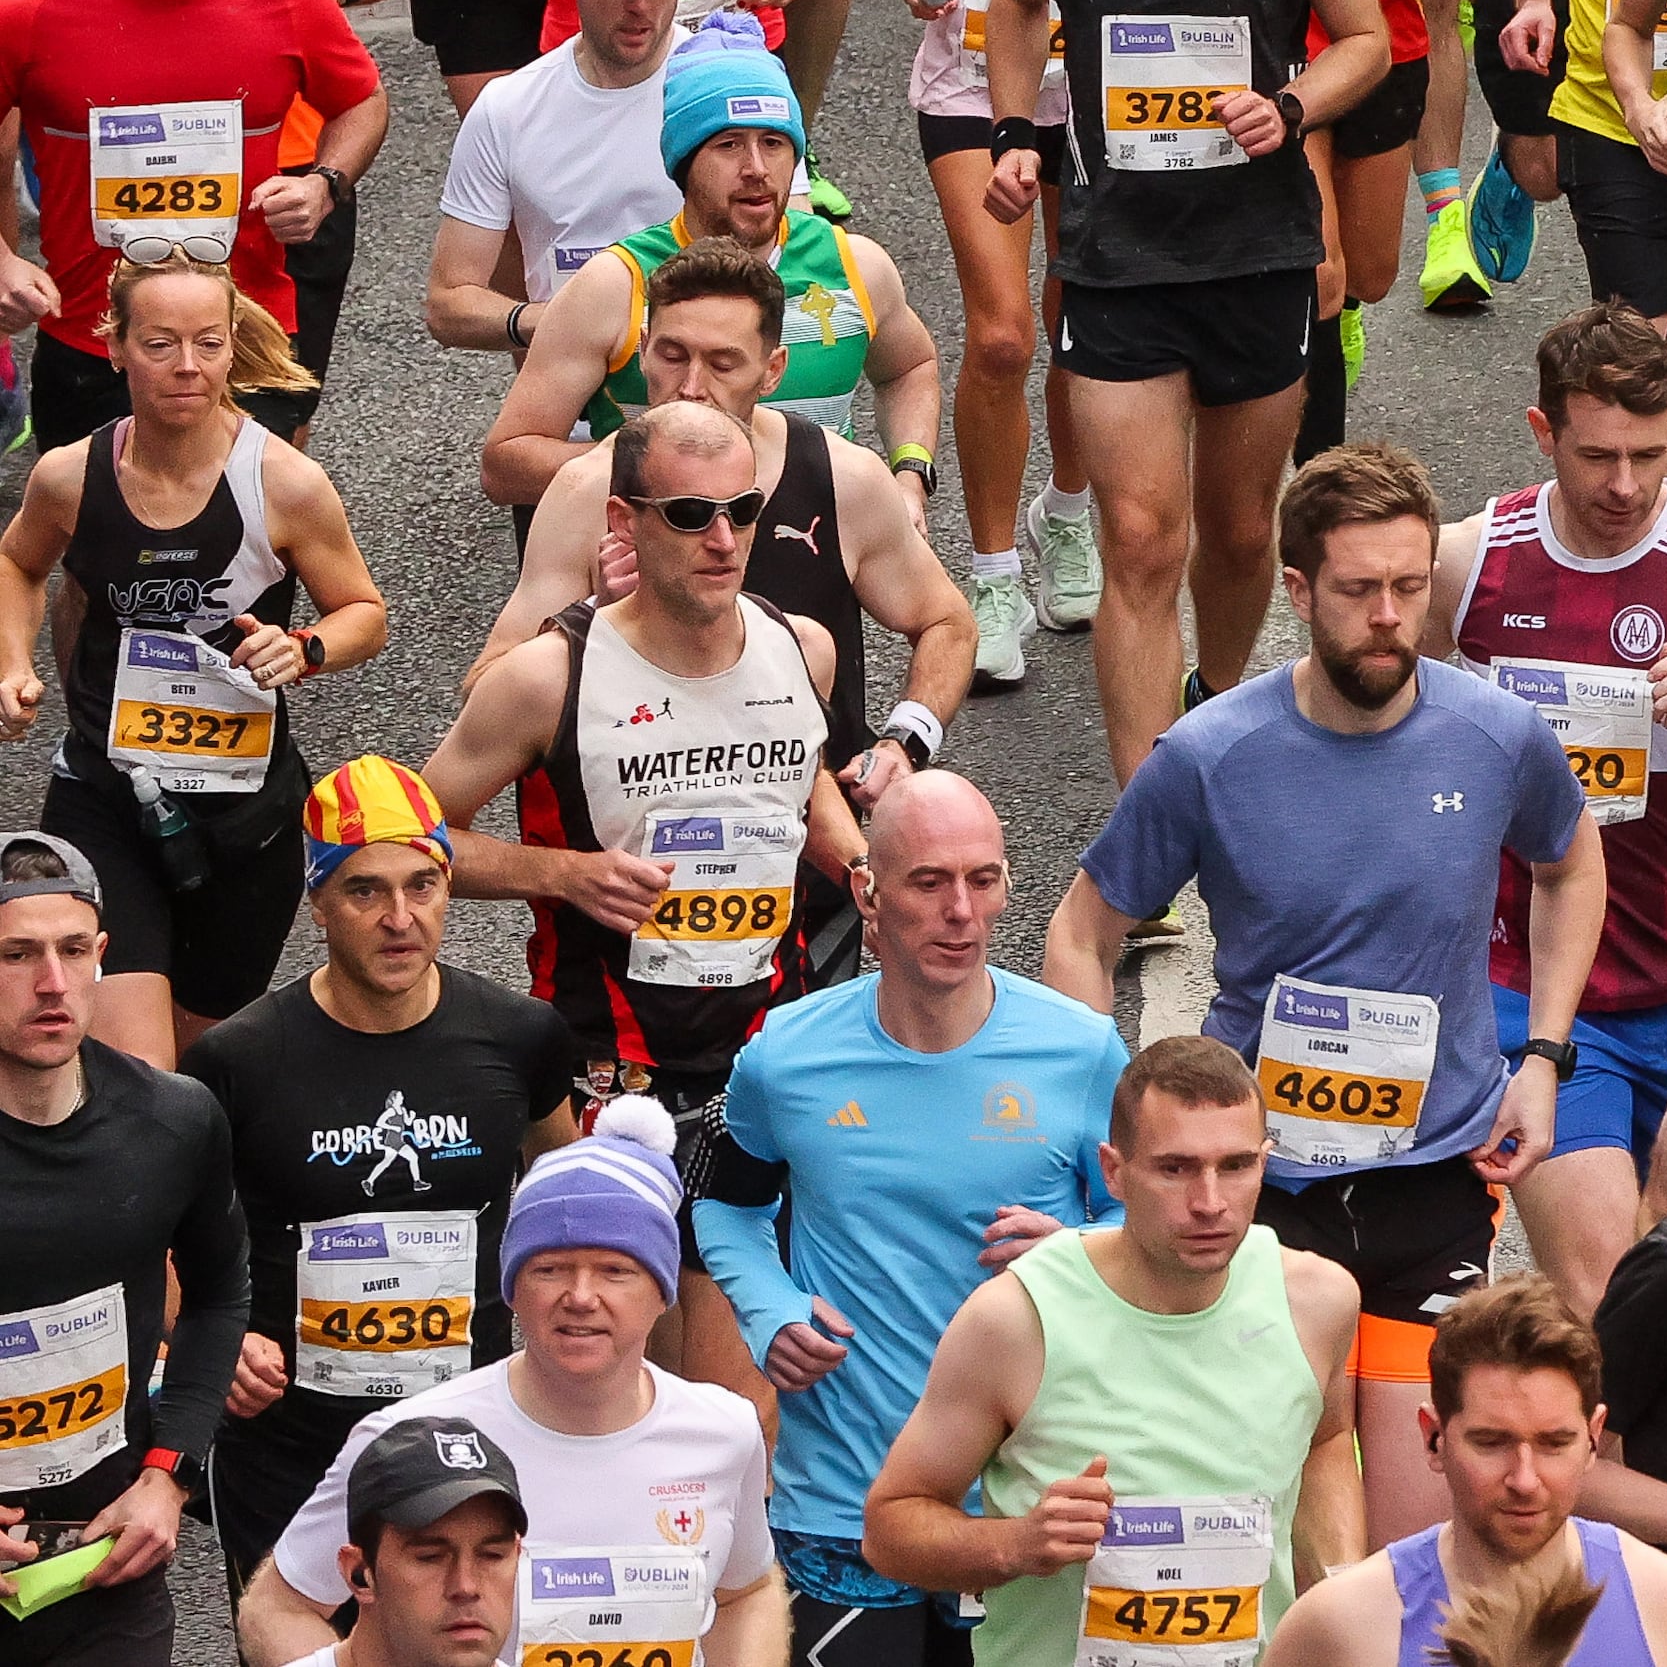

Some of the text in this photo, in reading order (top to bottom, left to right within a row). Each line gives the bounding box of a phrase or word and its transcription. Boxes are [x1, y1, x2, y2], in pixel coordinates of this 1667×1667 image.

[1127, 32, 1167, 46] Irish Life
[1181, 31, 1234, 47] DUBLIN
[1125, 92, 1233, 123] 3782
[1149, 133, 1179, 143] JAMES
[1164, 157, 1194, 168] 3782
[114, 179, 224, 213] 4283
[1502, 613, 1546, 628] KCS
[171, 683, 197, 695] BETH
[1514, 679, 1560, 697] Irish Life
[1575, 682, 1635, 701] DUBLIN
[136, 709, 249, 750] 3327
[617, 739, 806, 785] WATERFORD
[173, 779, 206, 790] 3327
[622, 770, 803, 799] TRIATHLON CLUB
[694, 863, 738, 876] STEPHEN
[654, 893, 777, 931] 4898
[697, 973, 733, 984] 4898
[1273, 1071, 1403, 1120] 4603
[397, 1231, 460, 1245] DUBLIN
[362, 1277, 400, 1293] XAVIER
[45, 1310, 108, 1336] DUBLIN
[321, 1307, 452, 1346] 4630
[365, 1384, 403, 1397] 4630
[0, 1386, 104, 1442] 5272
[38, 1469, 74, 1485] 5272
[1194, 1516, 1256, 1530] DUBLIN
[556, 1571, 605, 1587] Irish Life
[624, 1567, 689, 1582] DUBLIN
[1157, 1568, 1181, 1580] NOEL
[588, 1613, 622, 1626] DAVID
[1115, 1594, 1241, 1635] 4757
